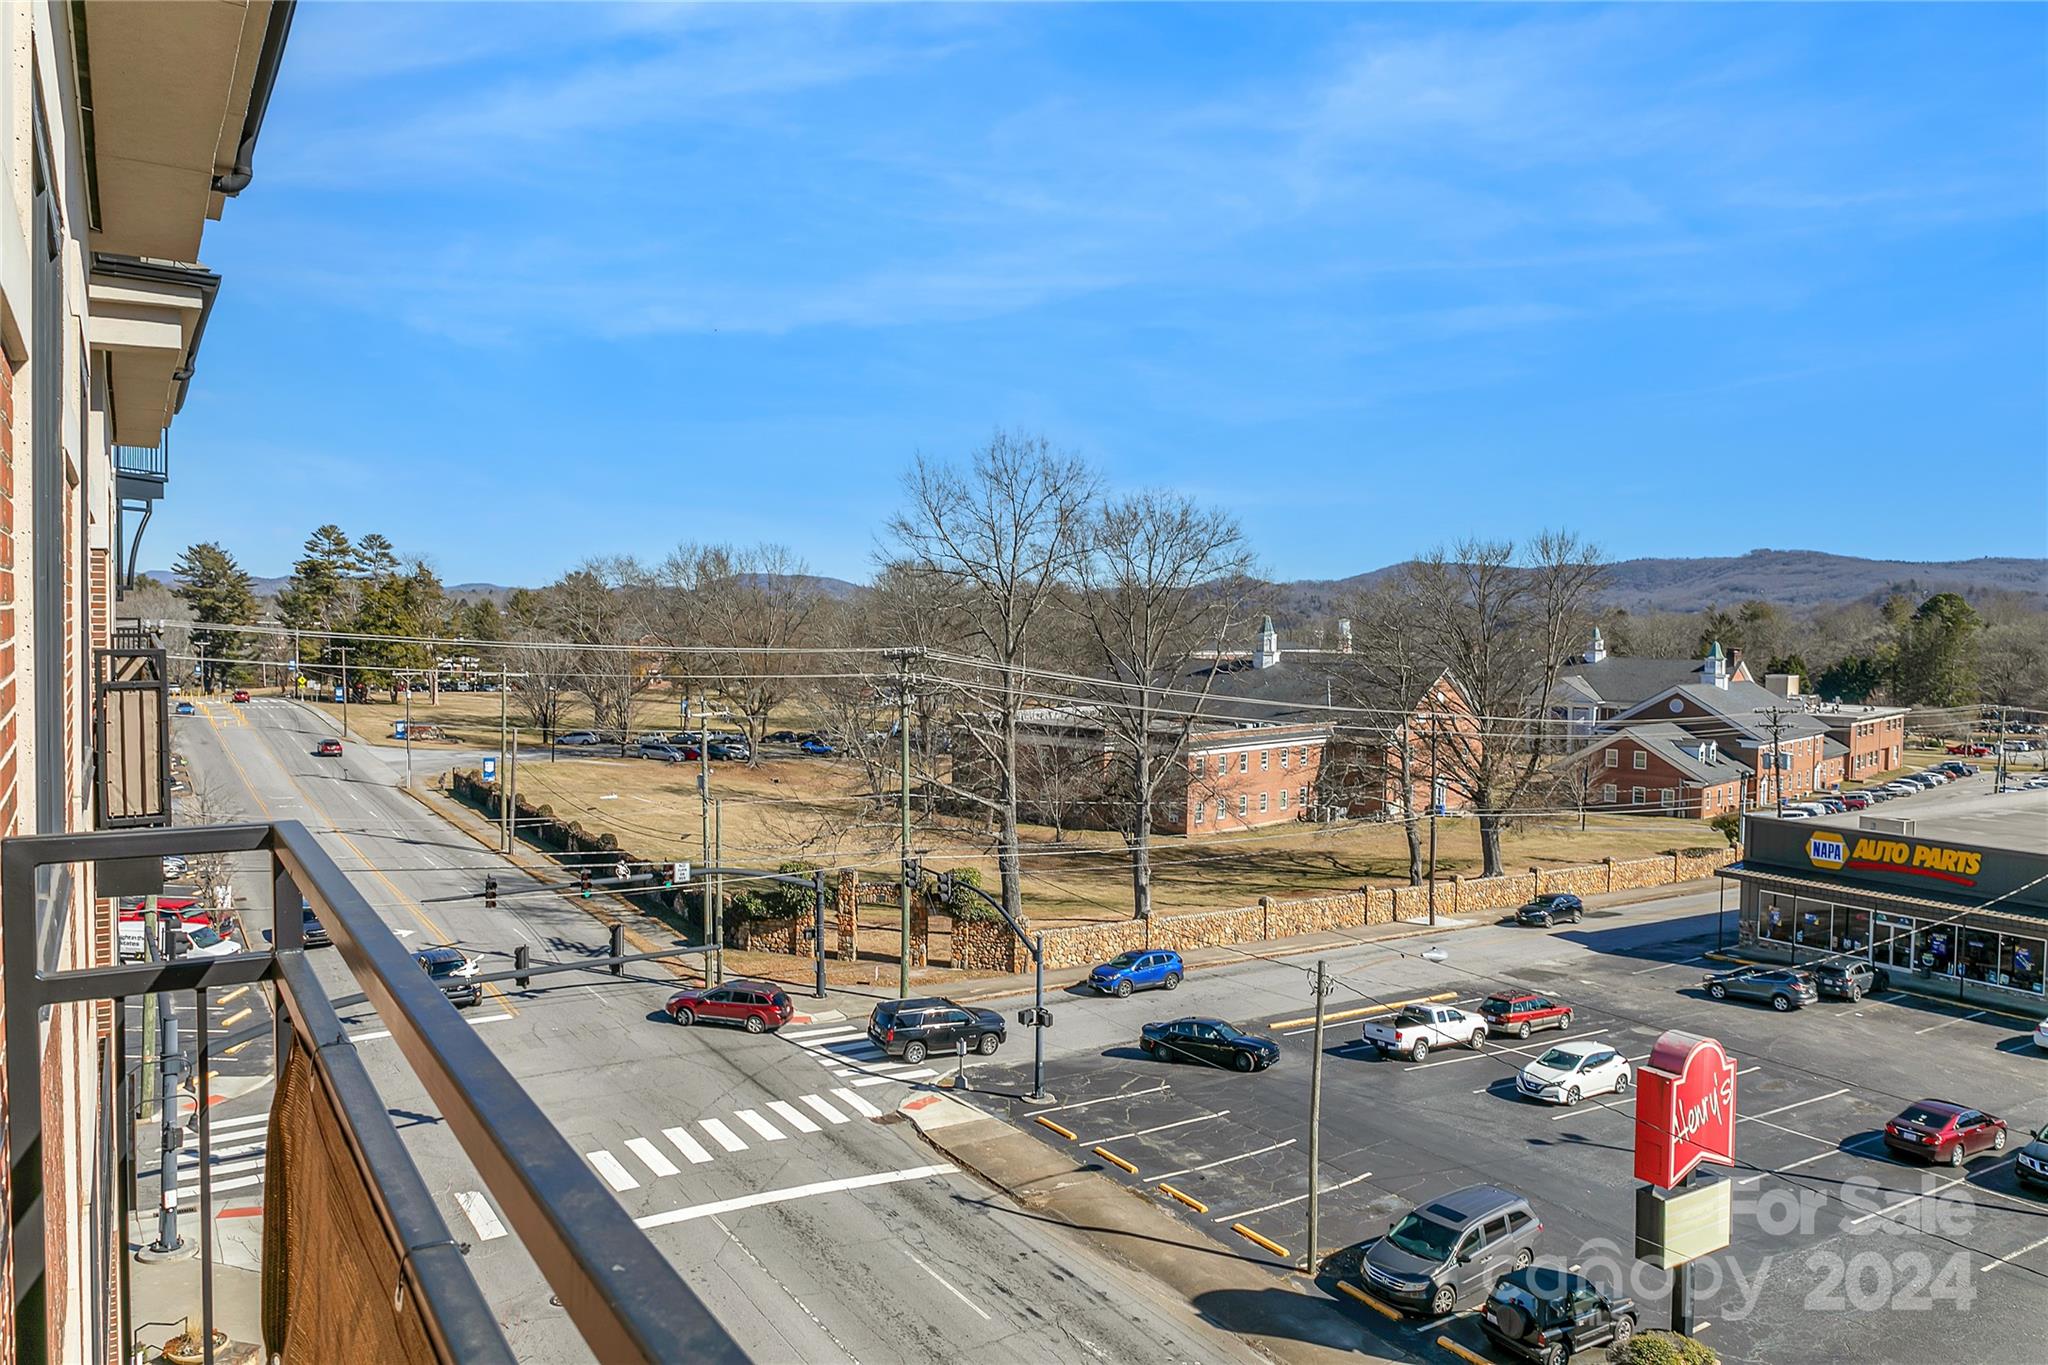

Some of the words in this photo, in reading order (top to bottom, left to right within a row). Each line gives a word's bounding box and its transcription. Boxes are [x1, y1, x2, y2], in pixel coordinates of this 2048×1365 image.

[1812, 841, 1841, 861] NAPA
[1852, 838, 1910, 864] AUTO
[1912, 845, 1982, 875] PARTS
[1673, 1071, 1733, 1145] Henry's
